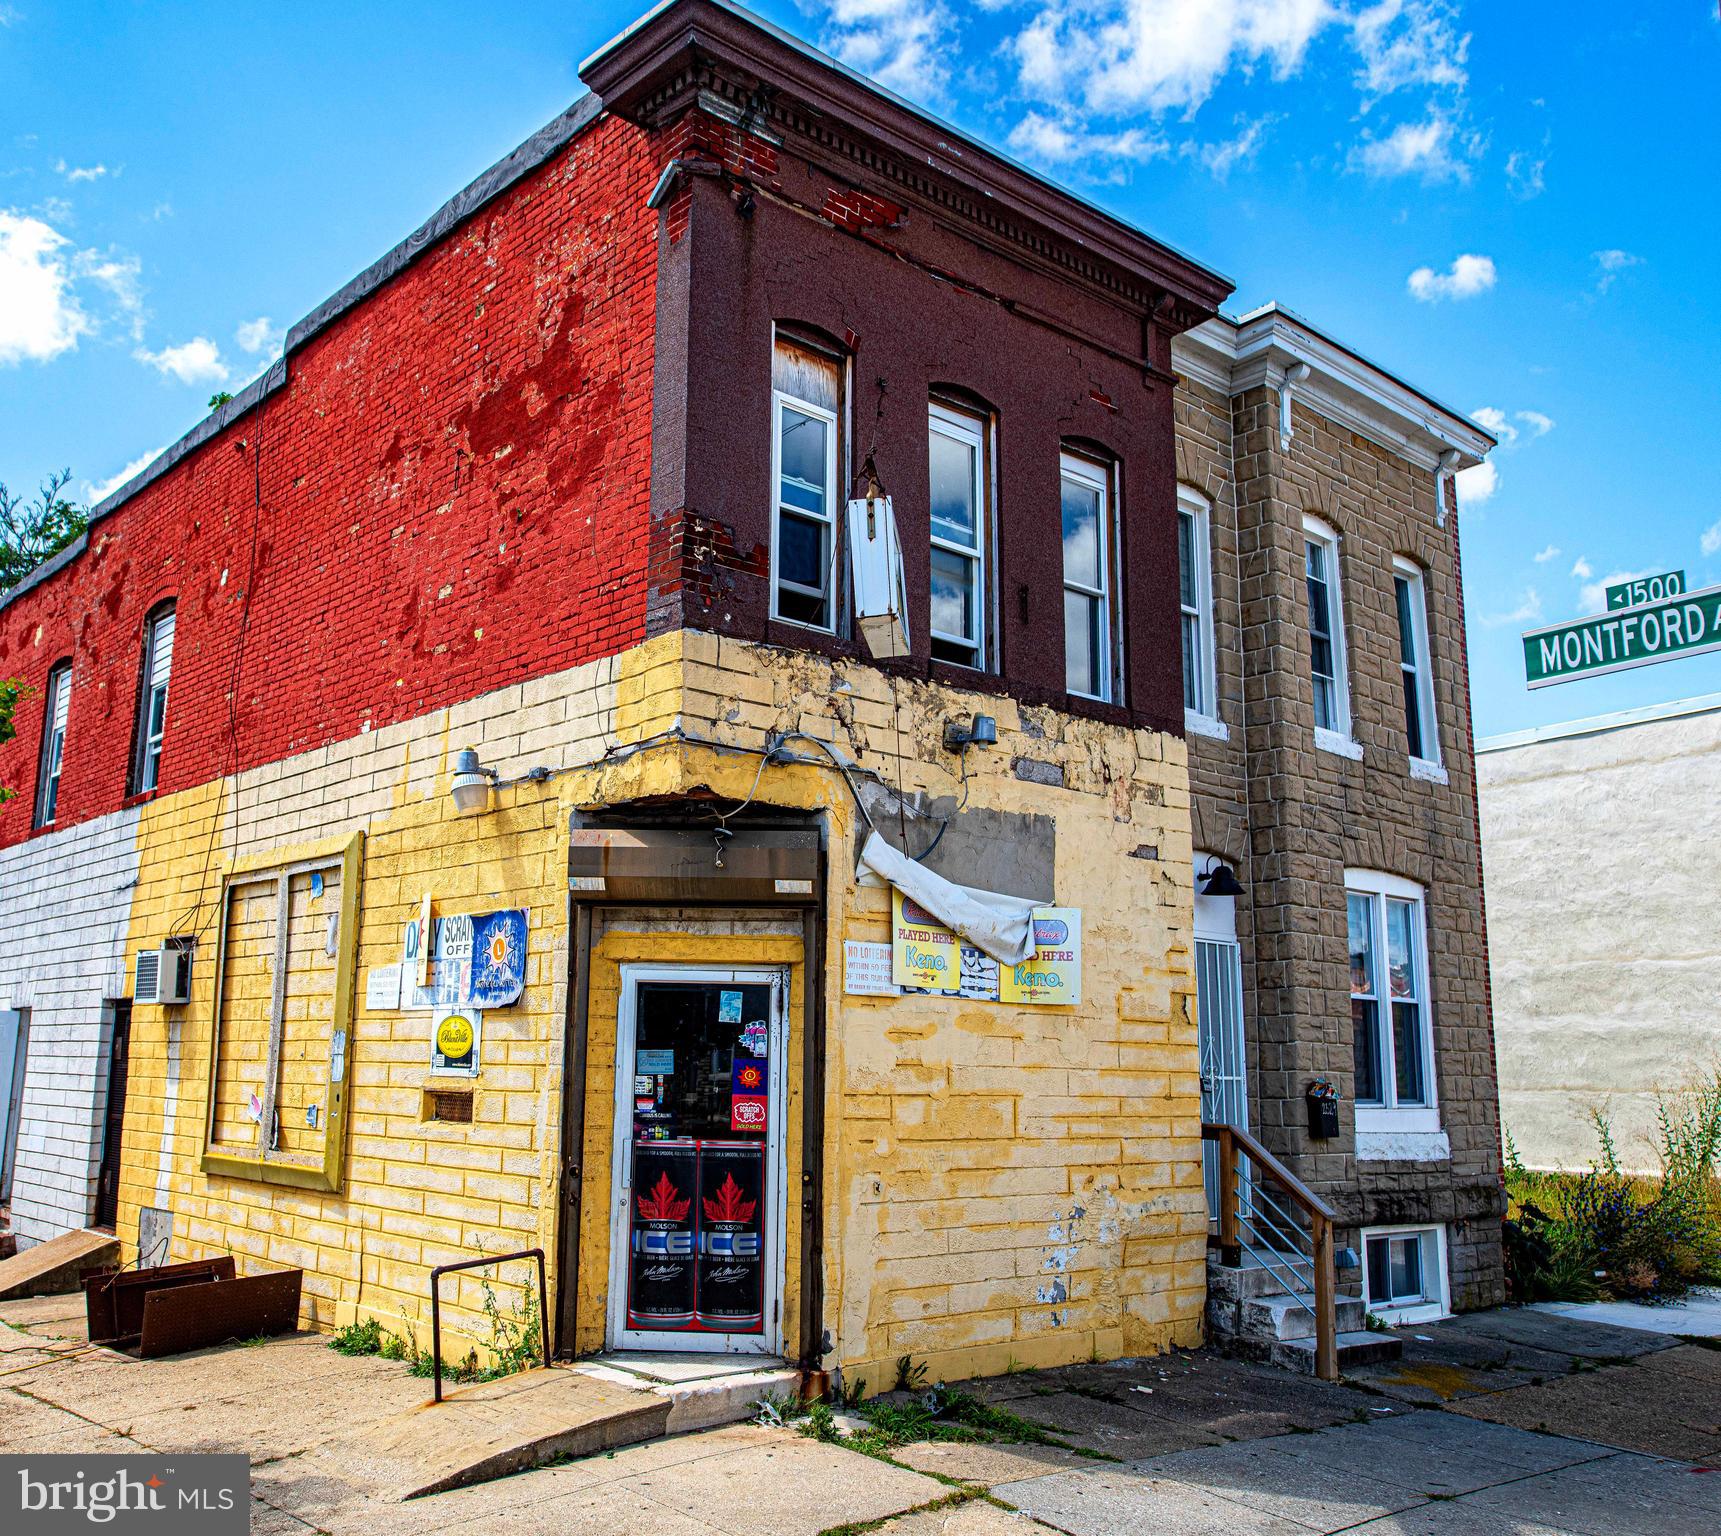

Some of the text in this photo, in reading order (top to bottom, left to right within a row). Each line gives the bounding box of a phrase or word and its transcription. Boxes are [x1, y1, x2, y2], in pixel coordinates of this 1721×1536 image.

[1626, 573, 1680, 607] 1500
[1539, 604, 1705, 674] MONTFORD
[898, 928, 955, 945] PLAYED HERE
[447, 944, 470, 955] OFF
[848, 946, 892, 960] NO LOITERIN
[636, 1230, 691, 1254] ICE
[701, 1232, 757, 1255] ICE
